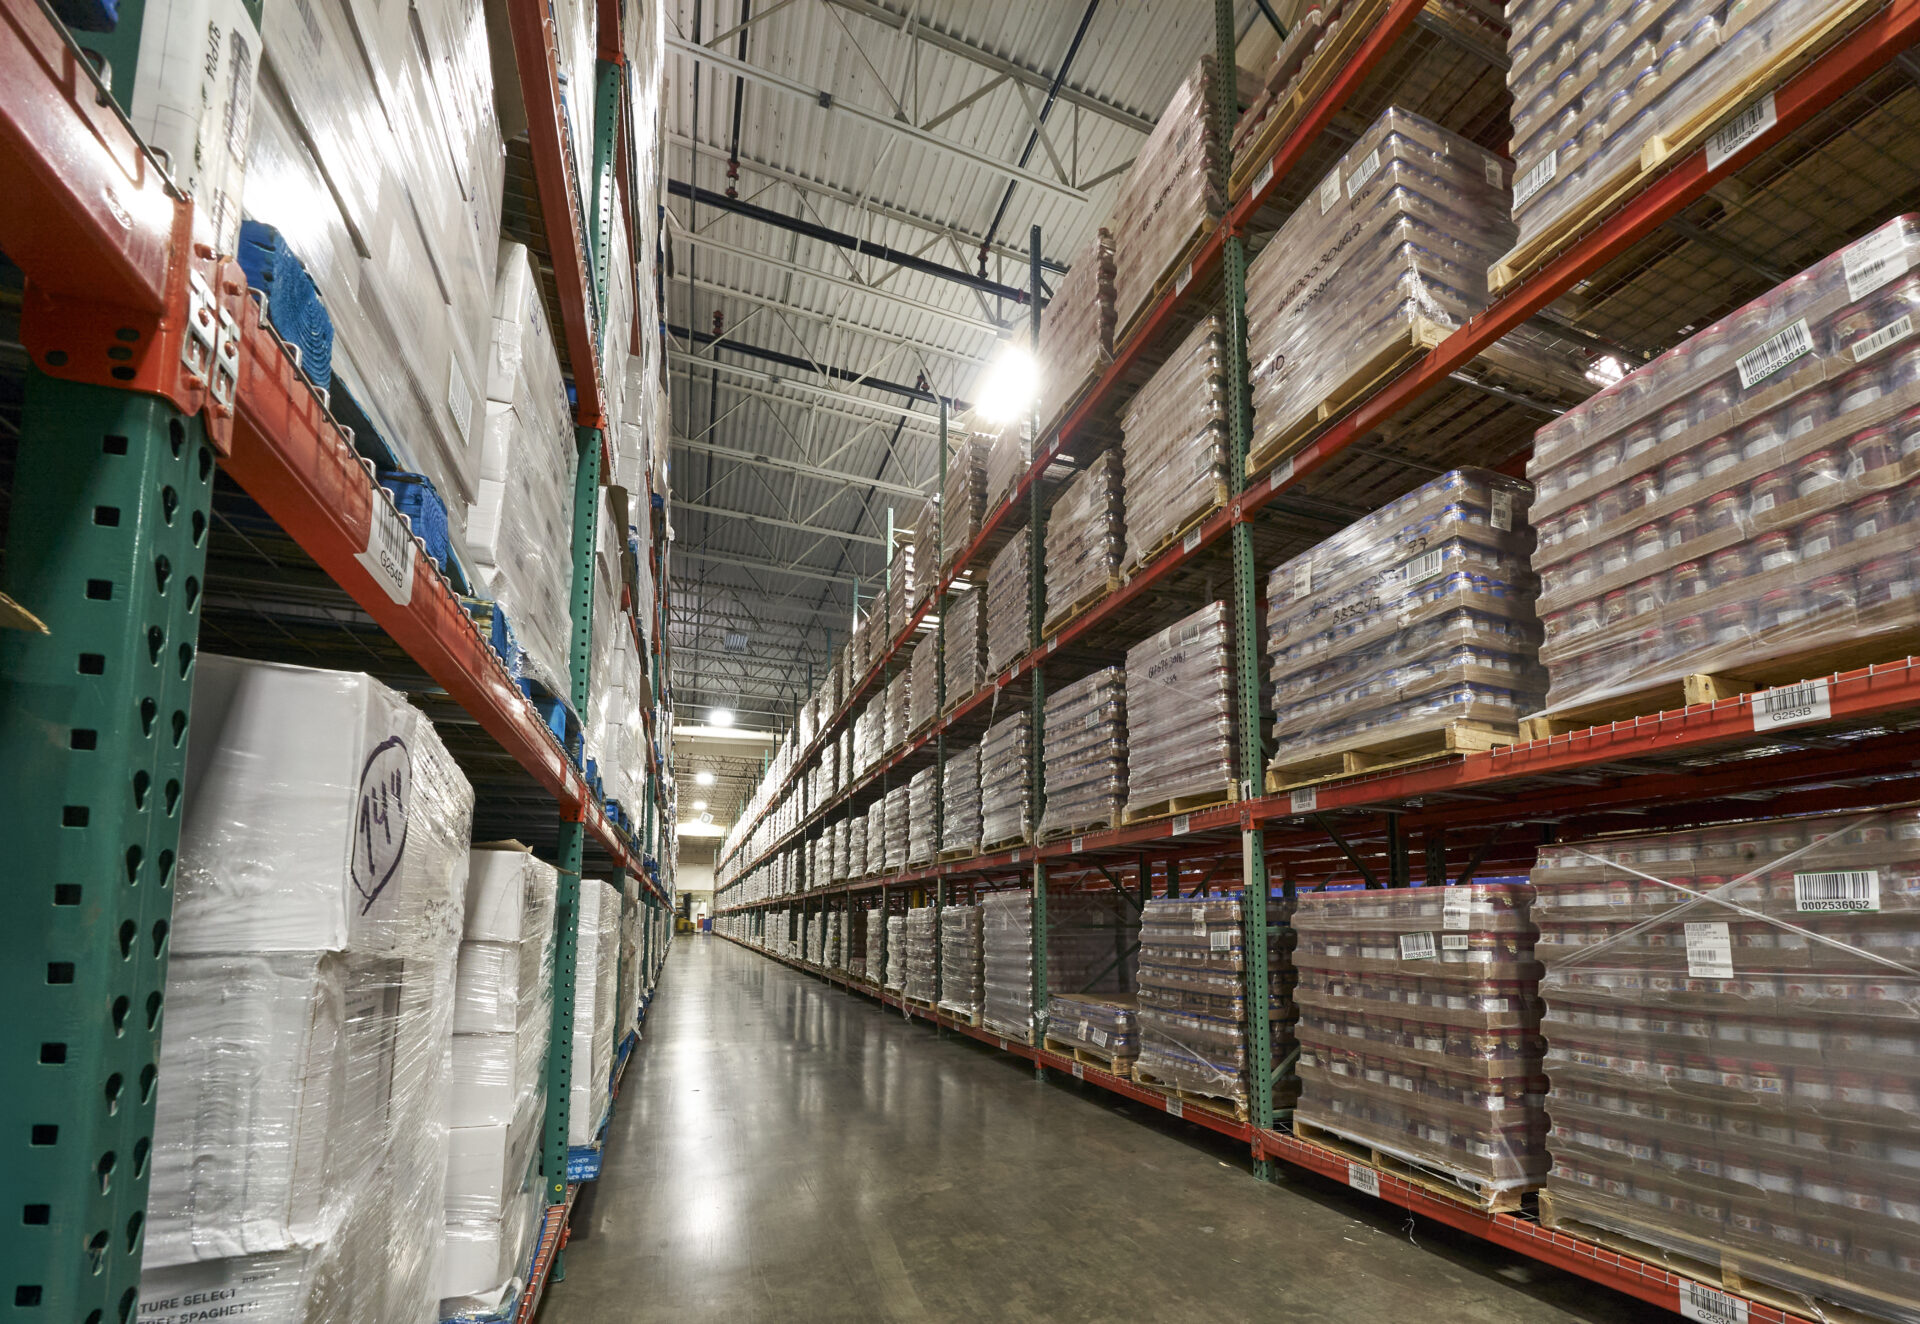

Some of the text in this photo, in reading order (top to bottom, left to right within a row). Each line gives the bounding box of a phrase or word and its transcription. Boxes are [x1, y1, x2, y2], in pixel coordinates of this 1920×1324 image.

[1724, 124, 1760, 154] G253C
[1748, 344, 1807, 385] 0002563049
[1408, 537, 1429, 553] 77
[380, 550, 403, 588] G254B
[1772, 707, 1812, 722] G253B
[1801, 900, 1870, 911] 0002536052
[183, 1288, 236, 1306] SELECT
